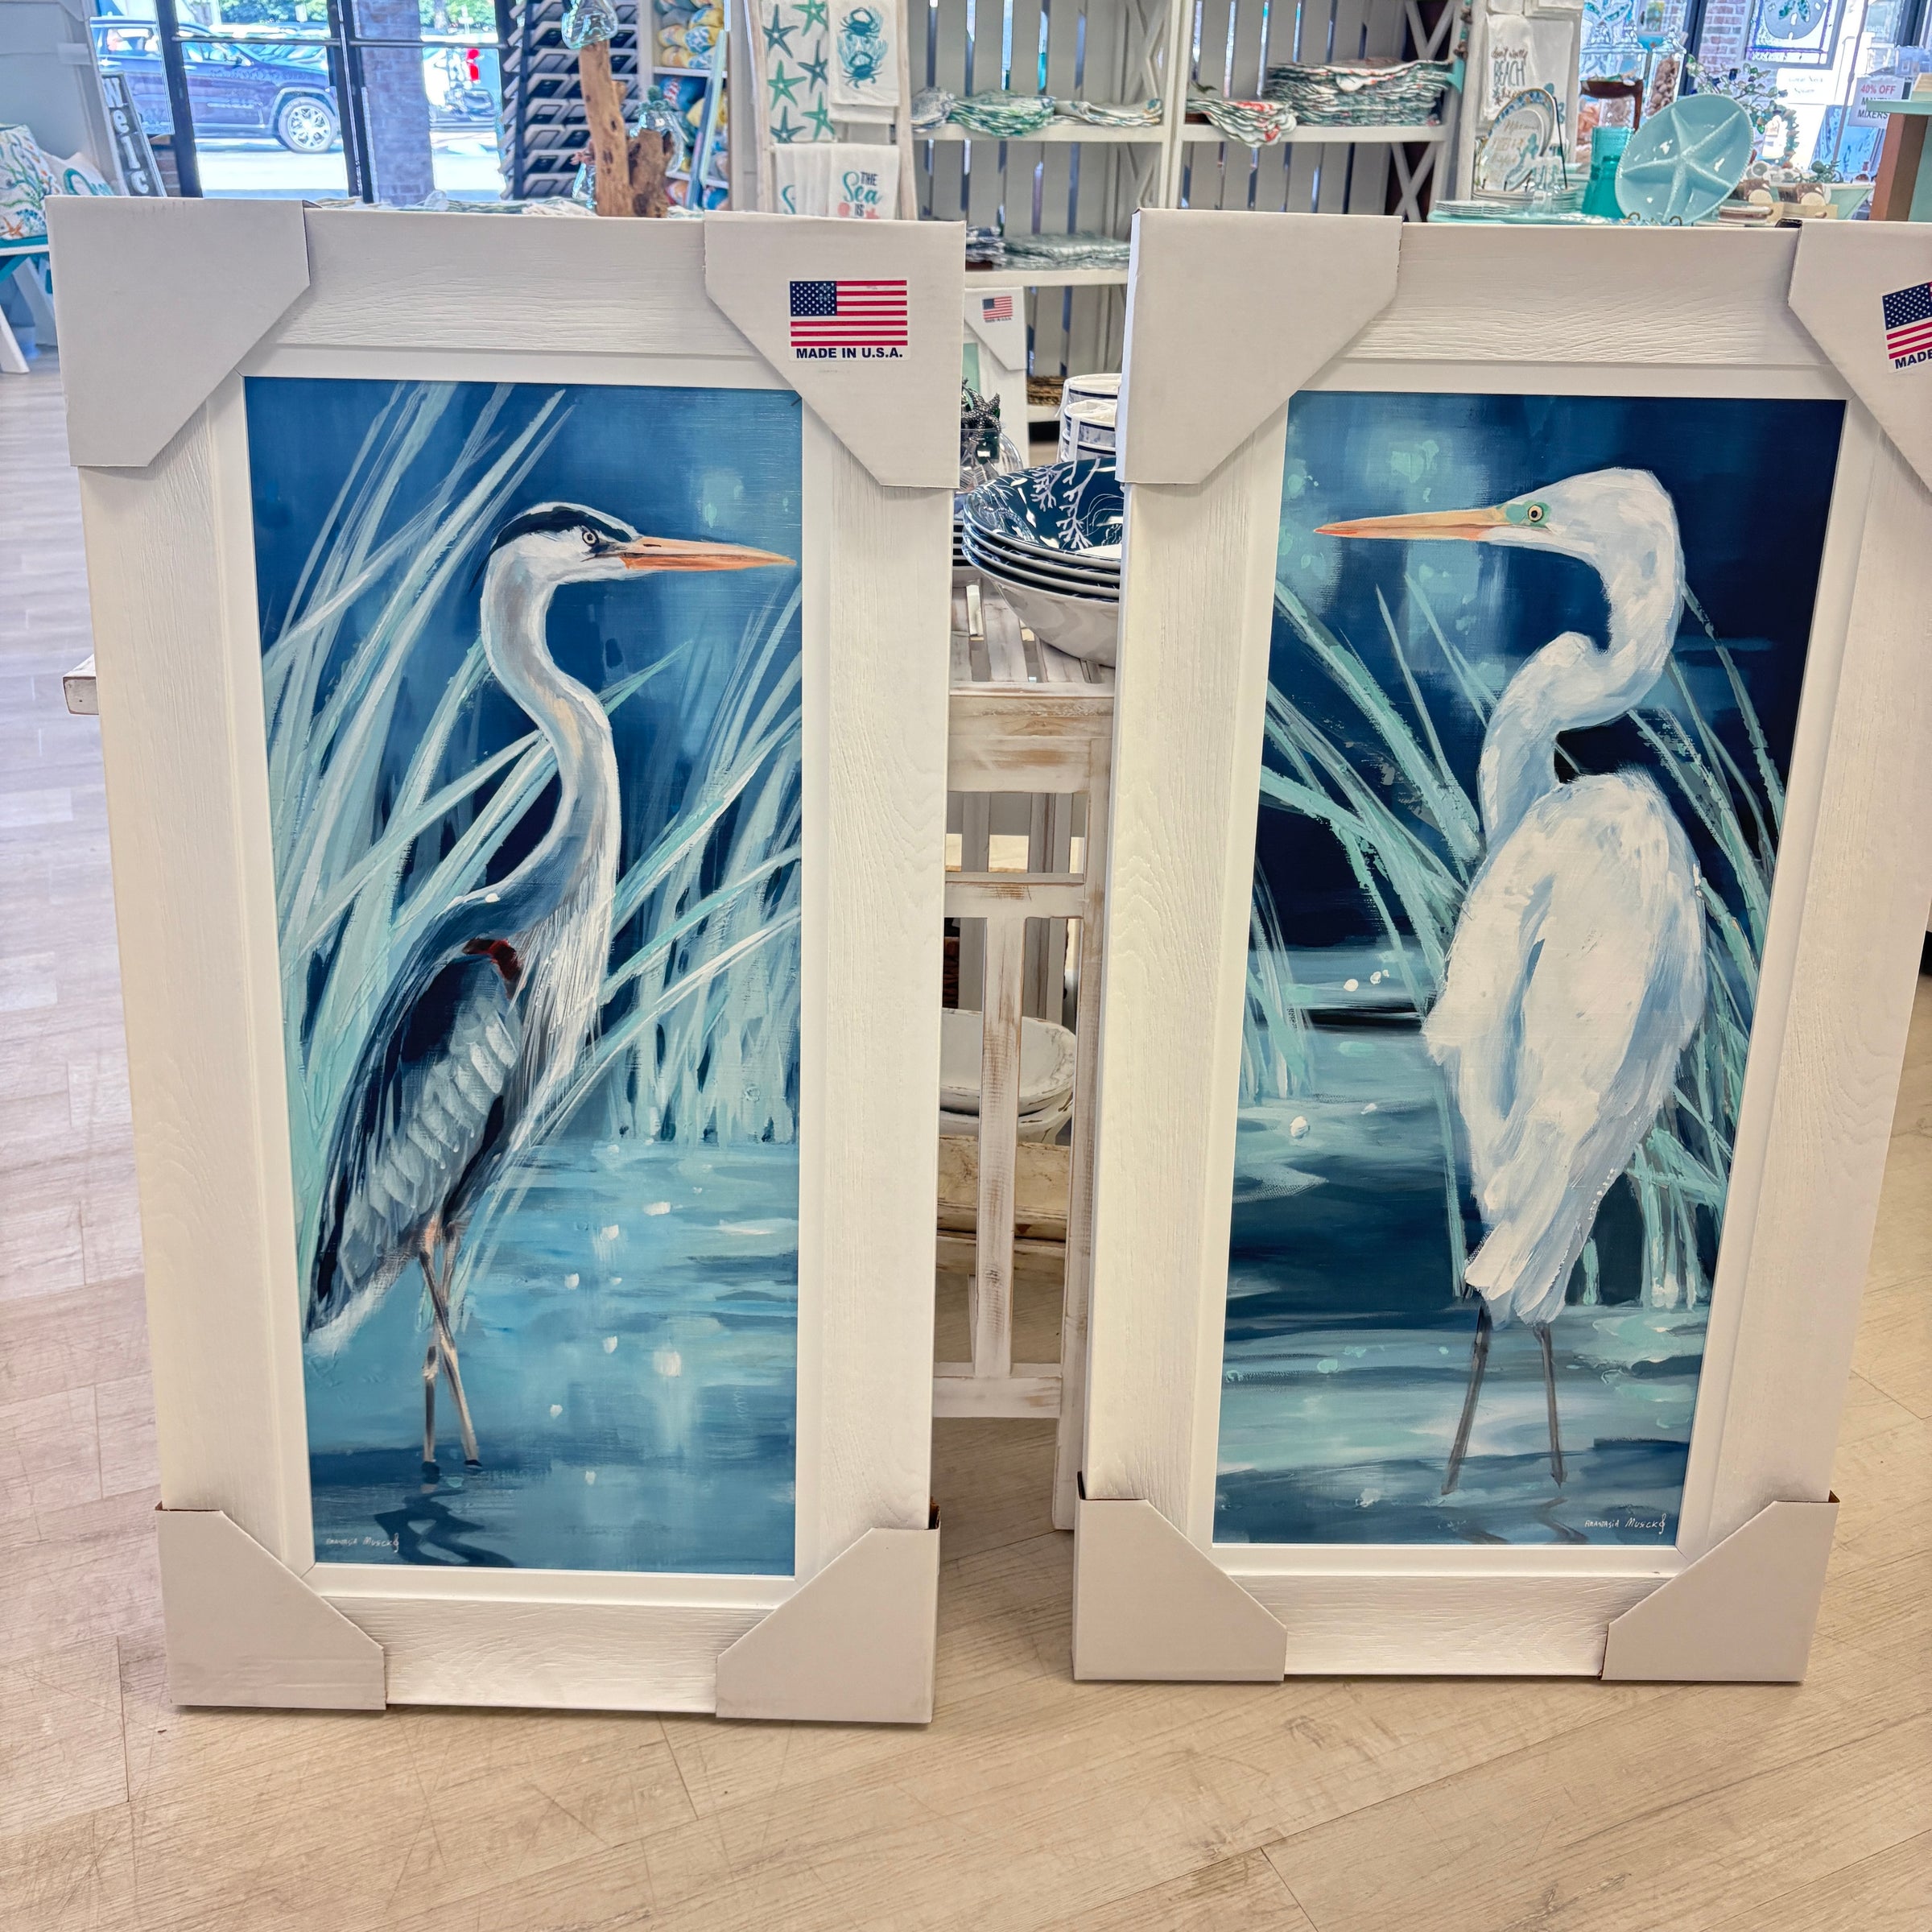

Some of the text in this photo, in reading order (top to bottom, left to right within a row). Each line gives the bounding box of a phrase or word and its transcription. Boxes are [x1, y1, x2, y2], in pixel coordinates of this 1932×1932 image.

[1860, 84, 1897, 94] 40% OFF
[1857, 109, 1889, 119] MIXERS
[861, 171, 878, 186] THE
[843, 171, 882, 205] Sea
[796, 347, 903, 359] MADE IN U.S.A.
